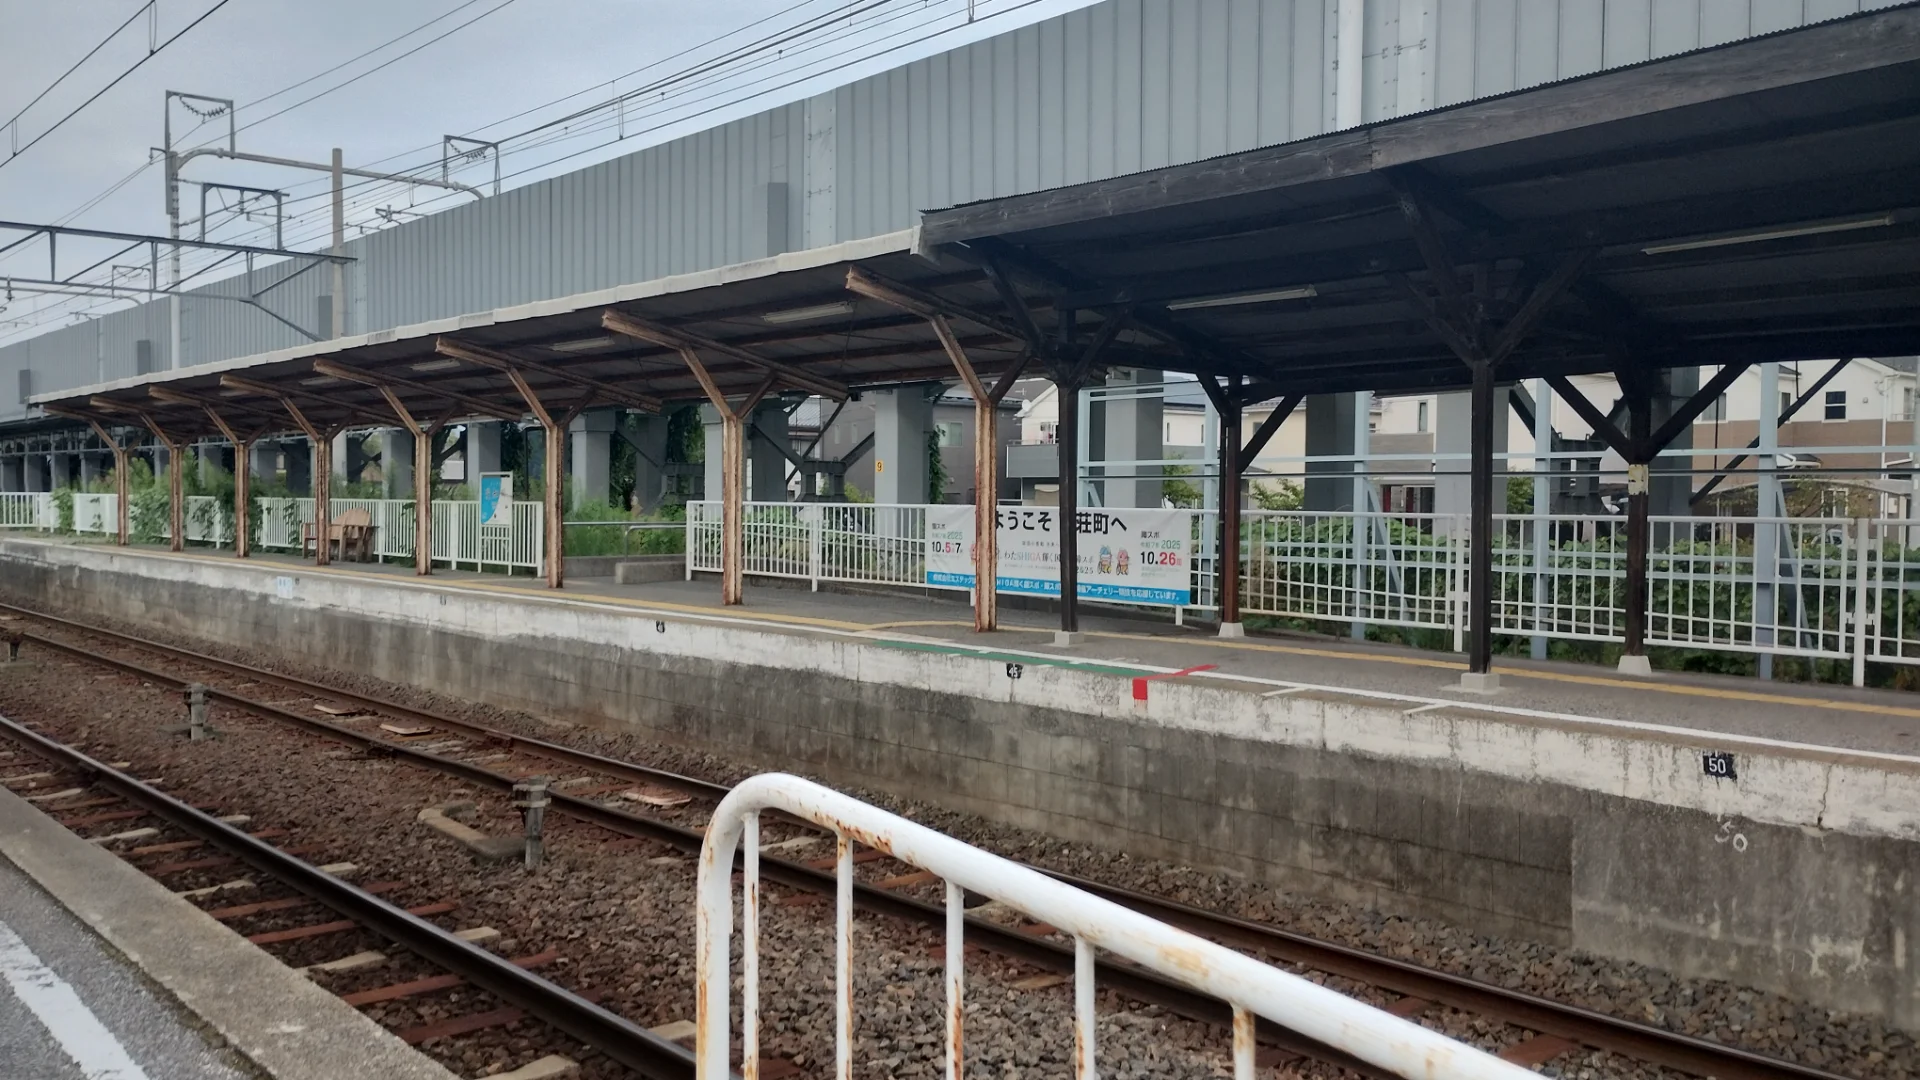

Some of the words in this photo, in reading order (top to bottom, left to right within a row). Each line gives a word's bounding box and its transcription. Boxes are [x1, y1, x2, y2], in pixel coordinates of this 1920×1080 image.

[1076, 512, 1127, 535] 荘町へ
[1161, 540, 1181, 550] 2025
[1708, 758, 1726, 774] 50
